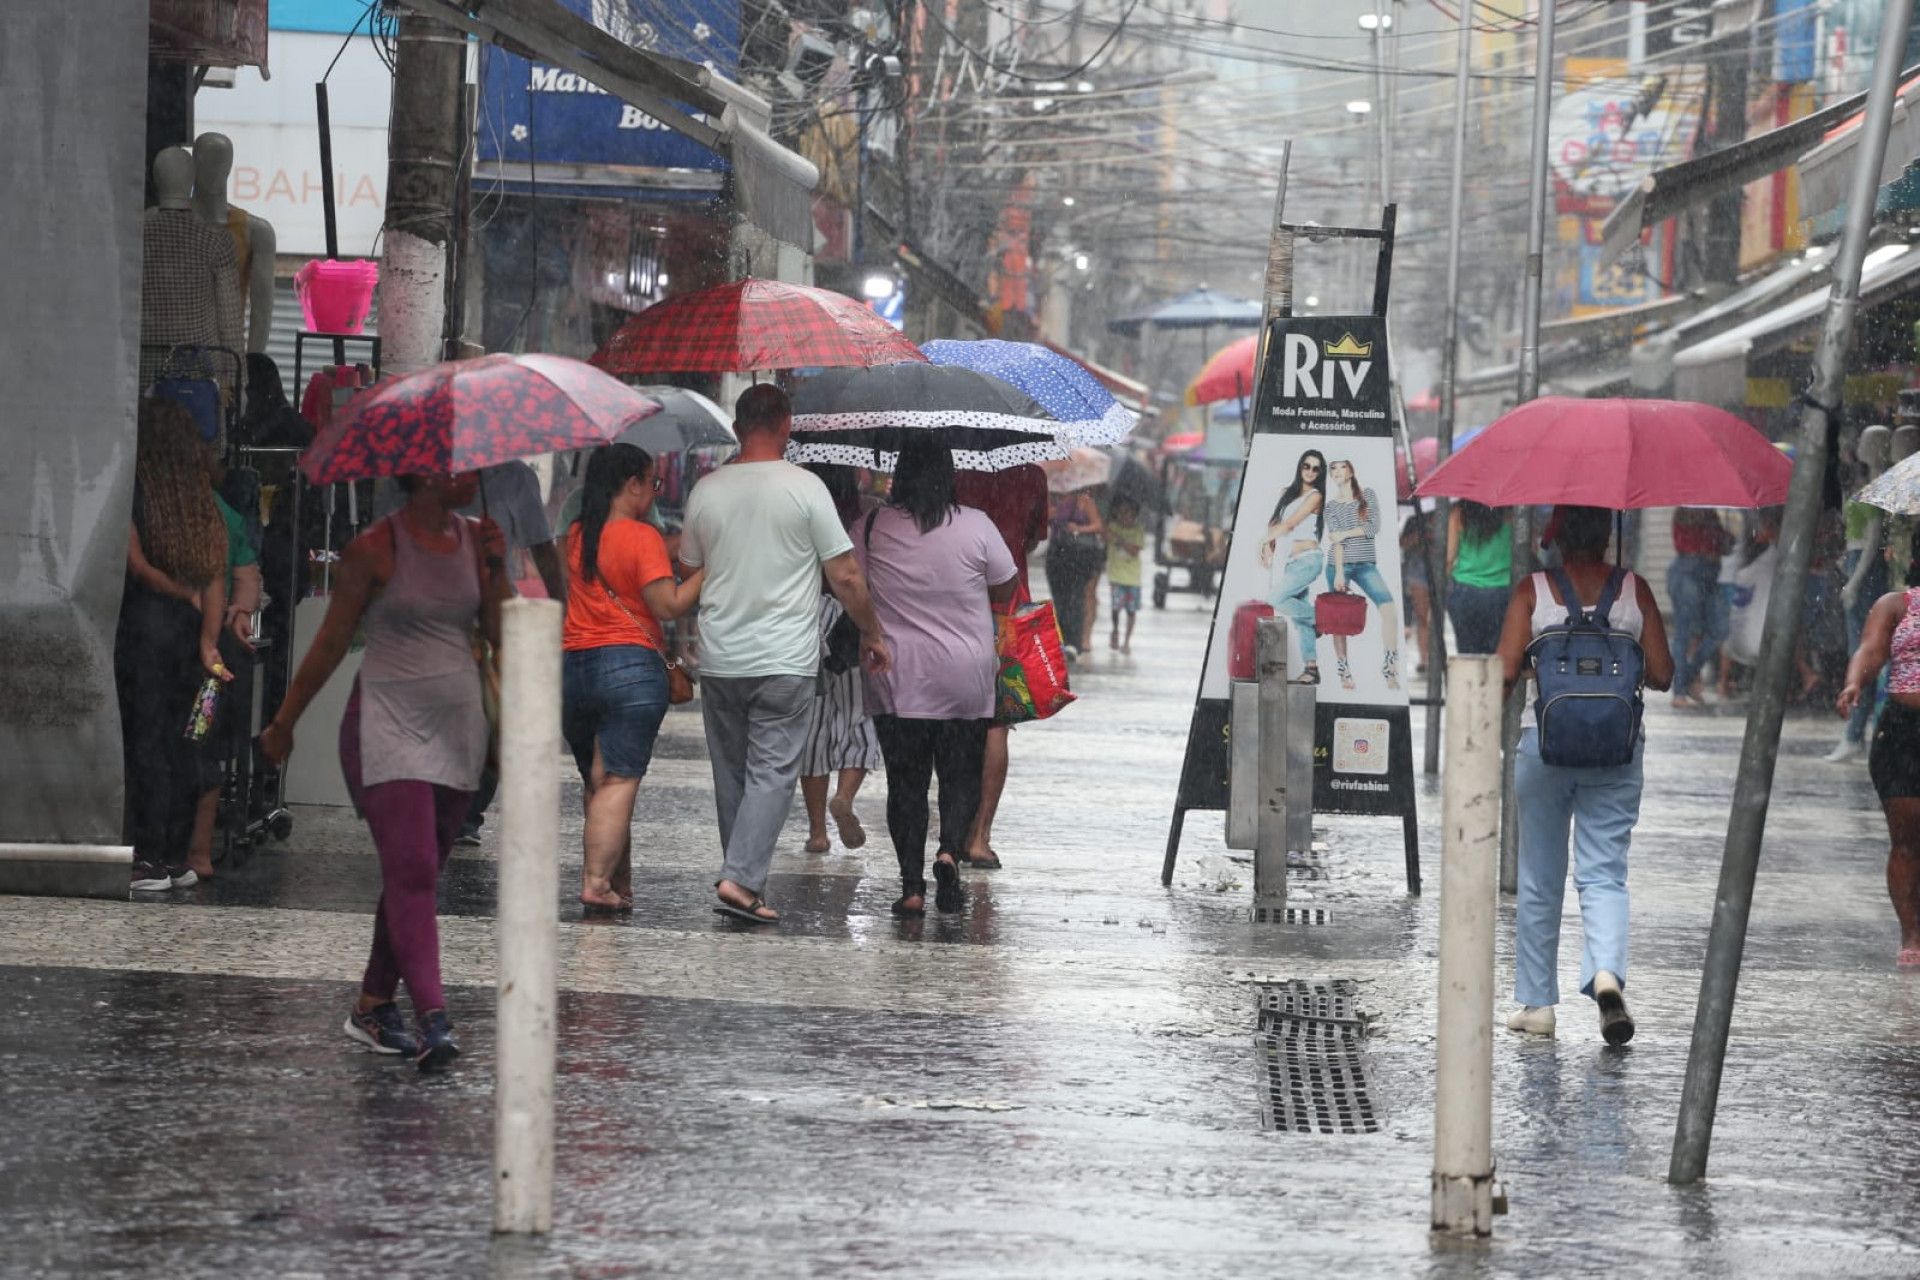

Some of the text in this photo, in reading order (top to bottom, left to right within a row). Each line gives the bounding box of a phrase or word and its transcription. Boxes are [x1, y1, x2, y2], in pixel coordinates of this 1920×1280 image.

[233, 166, 381, 208] BAHIA
[1272, 407, 1385, 419] Moda Feminina, Masculina
[1308, 421, 1356, 431] Acessórios
[1330, 779, 1389, 792] @rivfashion
